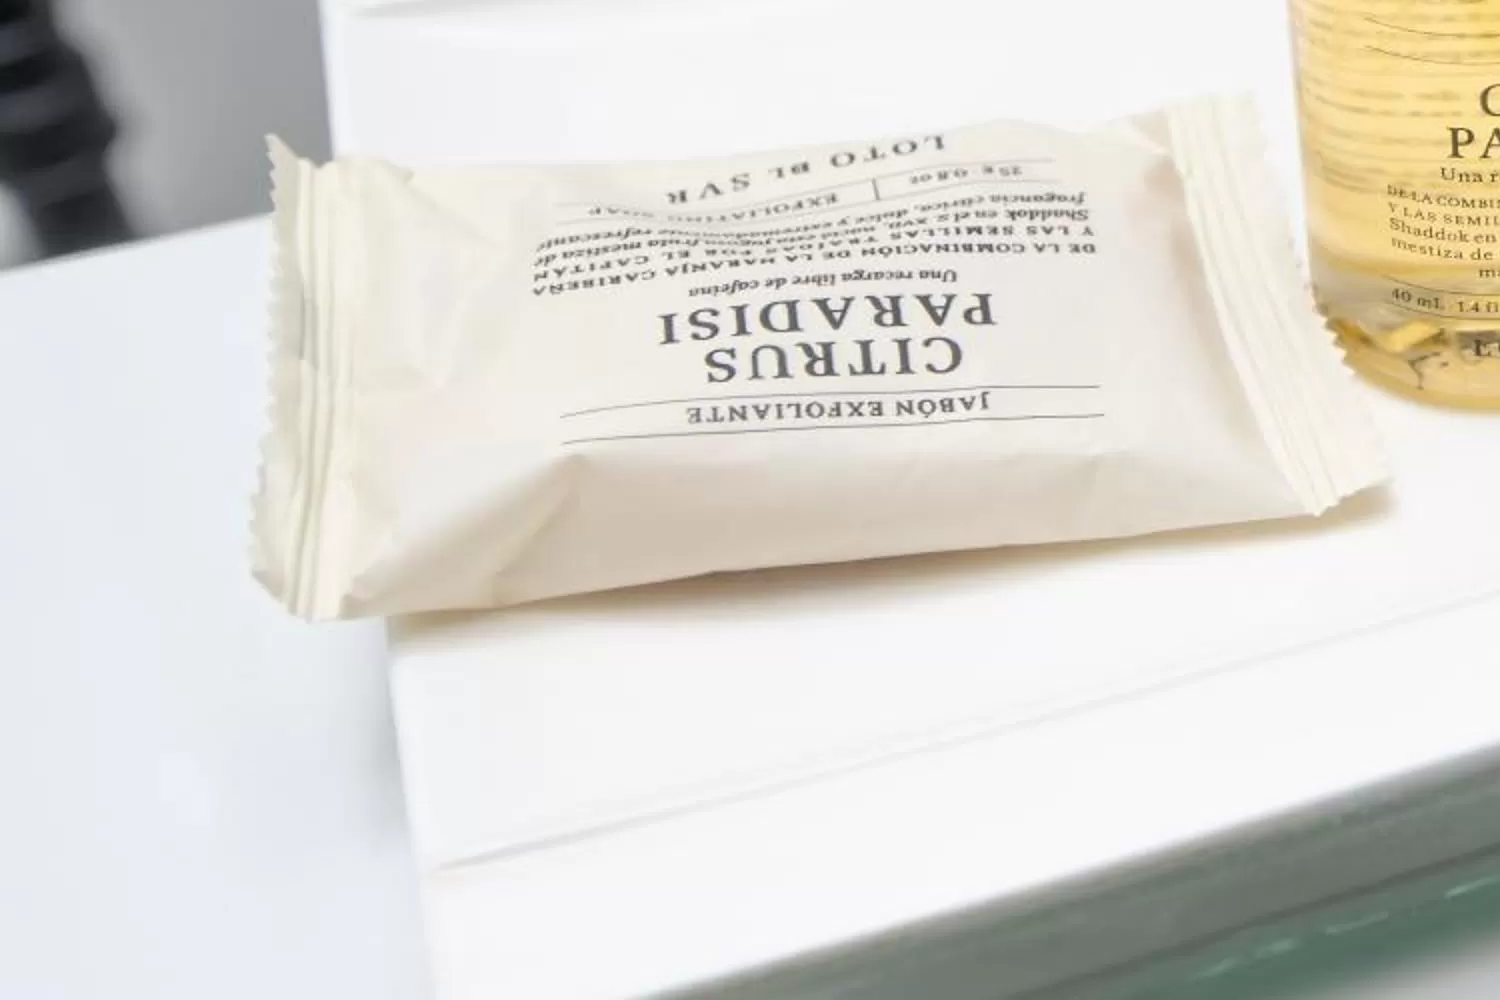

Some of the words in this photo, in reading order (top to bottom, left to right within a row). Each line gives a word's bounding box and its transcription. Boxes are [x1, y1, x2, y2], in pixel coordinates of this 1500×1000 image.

[829, 134, 944, 169] LOTO
[1440, 167, 1484, 184] Una
[665, 172, 751, 205] SVR
[989, 191, 1086, 205] fragancia
[954, 211, 970, 223] el
[974, 209, 998, 220] en
[1004, 208, 1089, 221] Shaddok
[1388, 201, 1399, 214] Y
[1403, 206, 1437, 222] LAS
[889, 225, 1014, 241] SEMILLAS
[1025, 225, 1069, 237] LAS
[1082, 225, 1094, 236] Y
[1389, 217, 1469, 244] Shaddok
[1473, 234, 1497, 244] en
[561, 240, 642, 258] mestiza
[661, 249, 690, 261] EL
[822, 249, 851, 260] DE
[860, 243, 1025, 259] COMBINACIÓN
[1033, 243, 1060, 254] LA
[1069, 243, 1097, 254] DE
[1391, 237, 1463, 260] mestiza
[1469, 247, 1493, 261] de
[532, 251, 557, 268] de
[784, 253, 813, 263] LA
[665, 259, 776, 277] NARANJA
[841, 269, 913, 282] recarga
[919, 269, 957, 283] Una
[532, 269, 656, 297] CARIBEÑA
[764, 278, 788, 291] de
[791, 273, 836, 287] libre
[1392, 287, 1412, 303] 40
[656, 293, 997, 345] PARADISI
[704, 336, 963, 384] CITRUS
[686, 400, 884, 425] EXFOLIANTE
[894, 391, 990, 419] JABÓN
